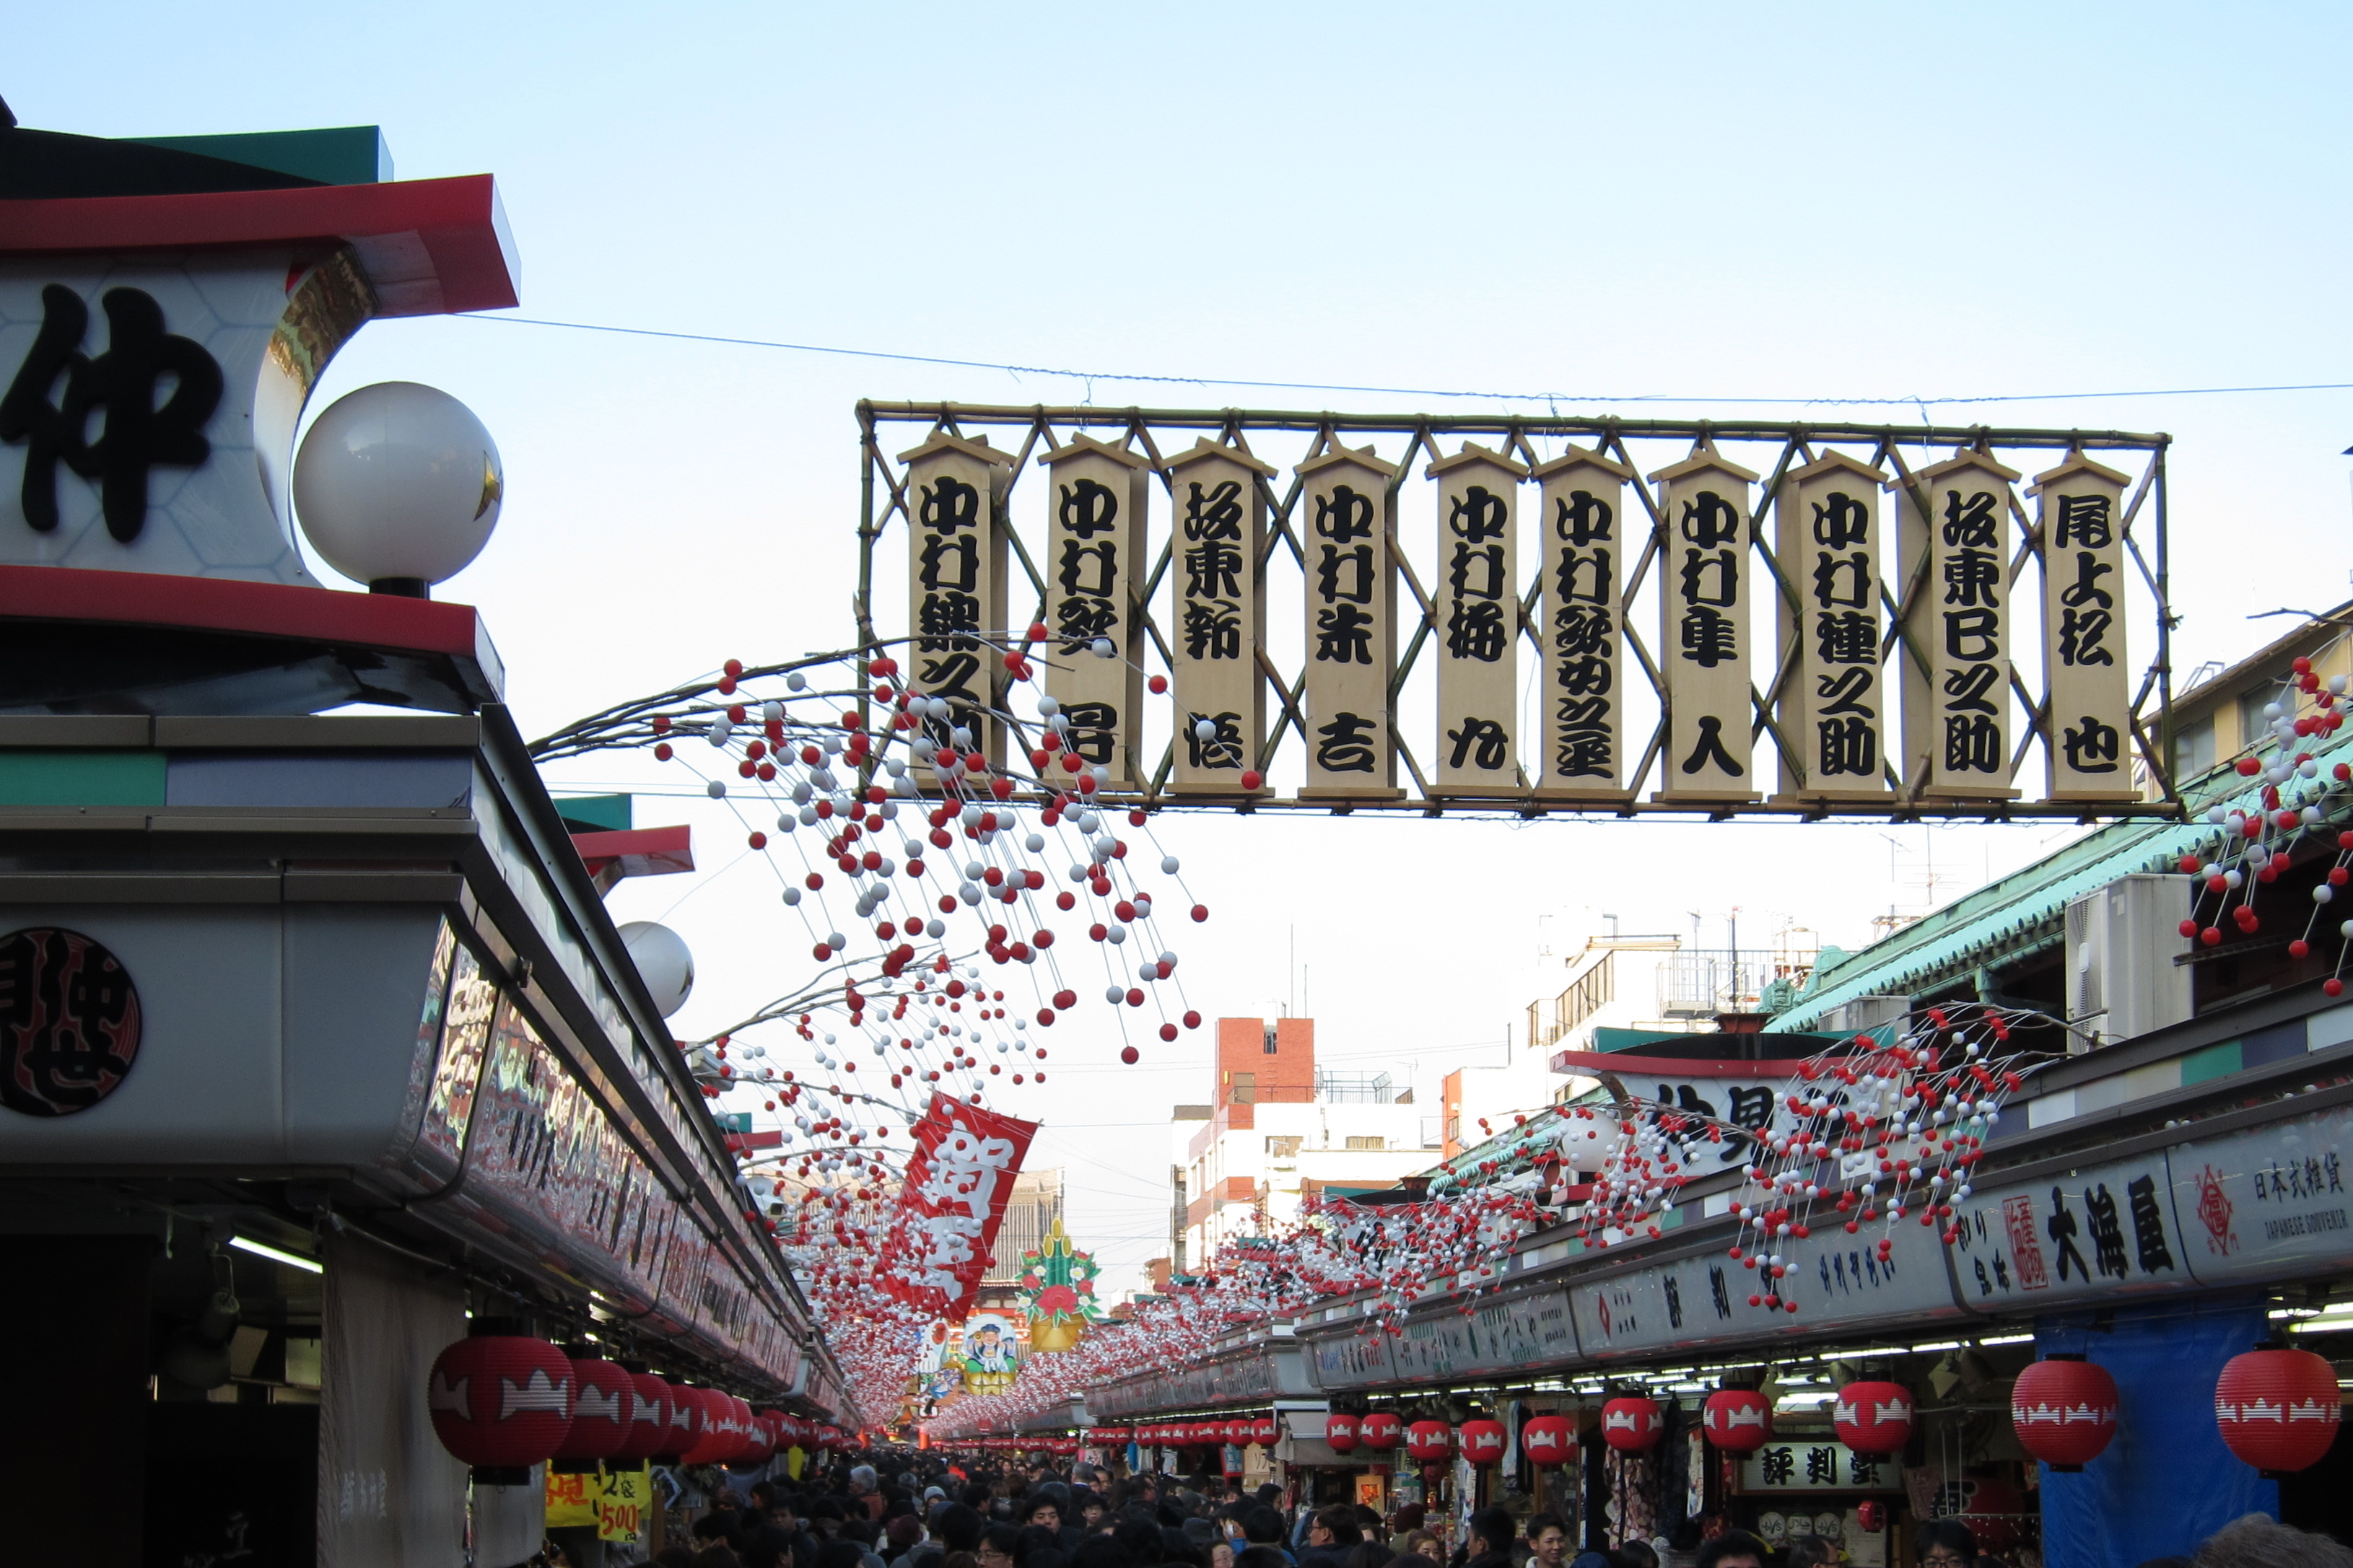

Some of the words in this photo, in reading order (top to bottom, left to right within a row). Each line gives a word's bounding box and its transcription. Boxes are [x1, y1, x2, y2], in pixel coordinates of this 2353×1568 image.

[2265, 1216, 2305, 1240] JAPANESE
[2305, 1209, 2349, 1234] SOUVENIR
[601, 1502, 638, 1536] 500
